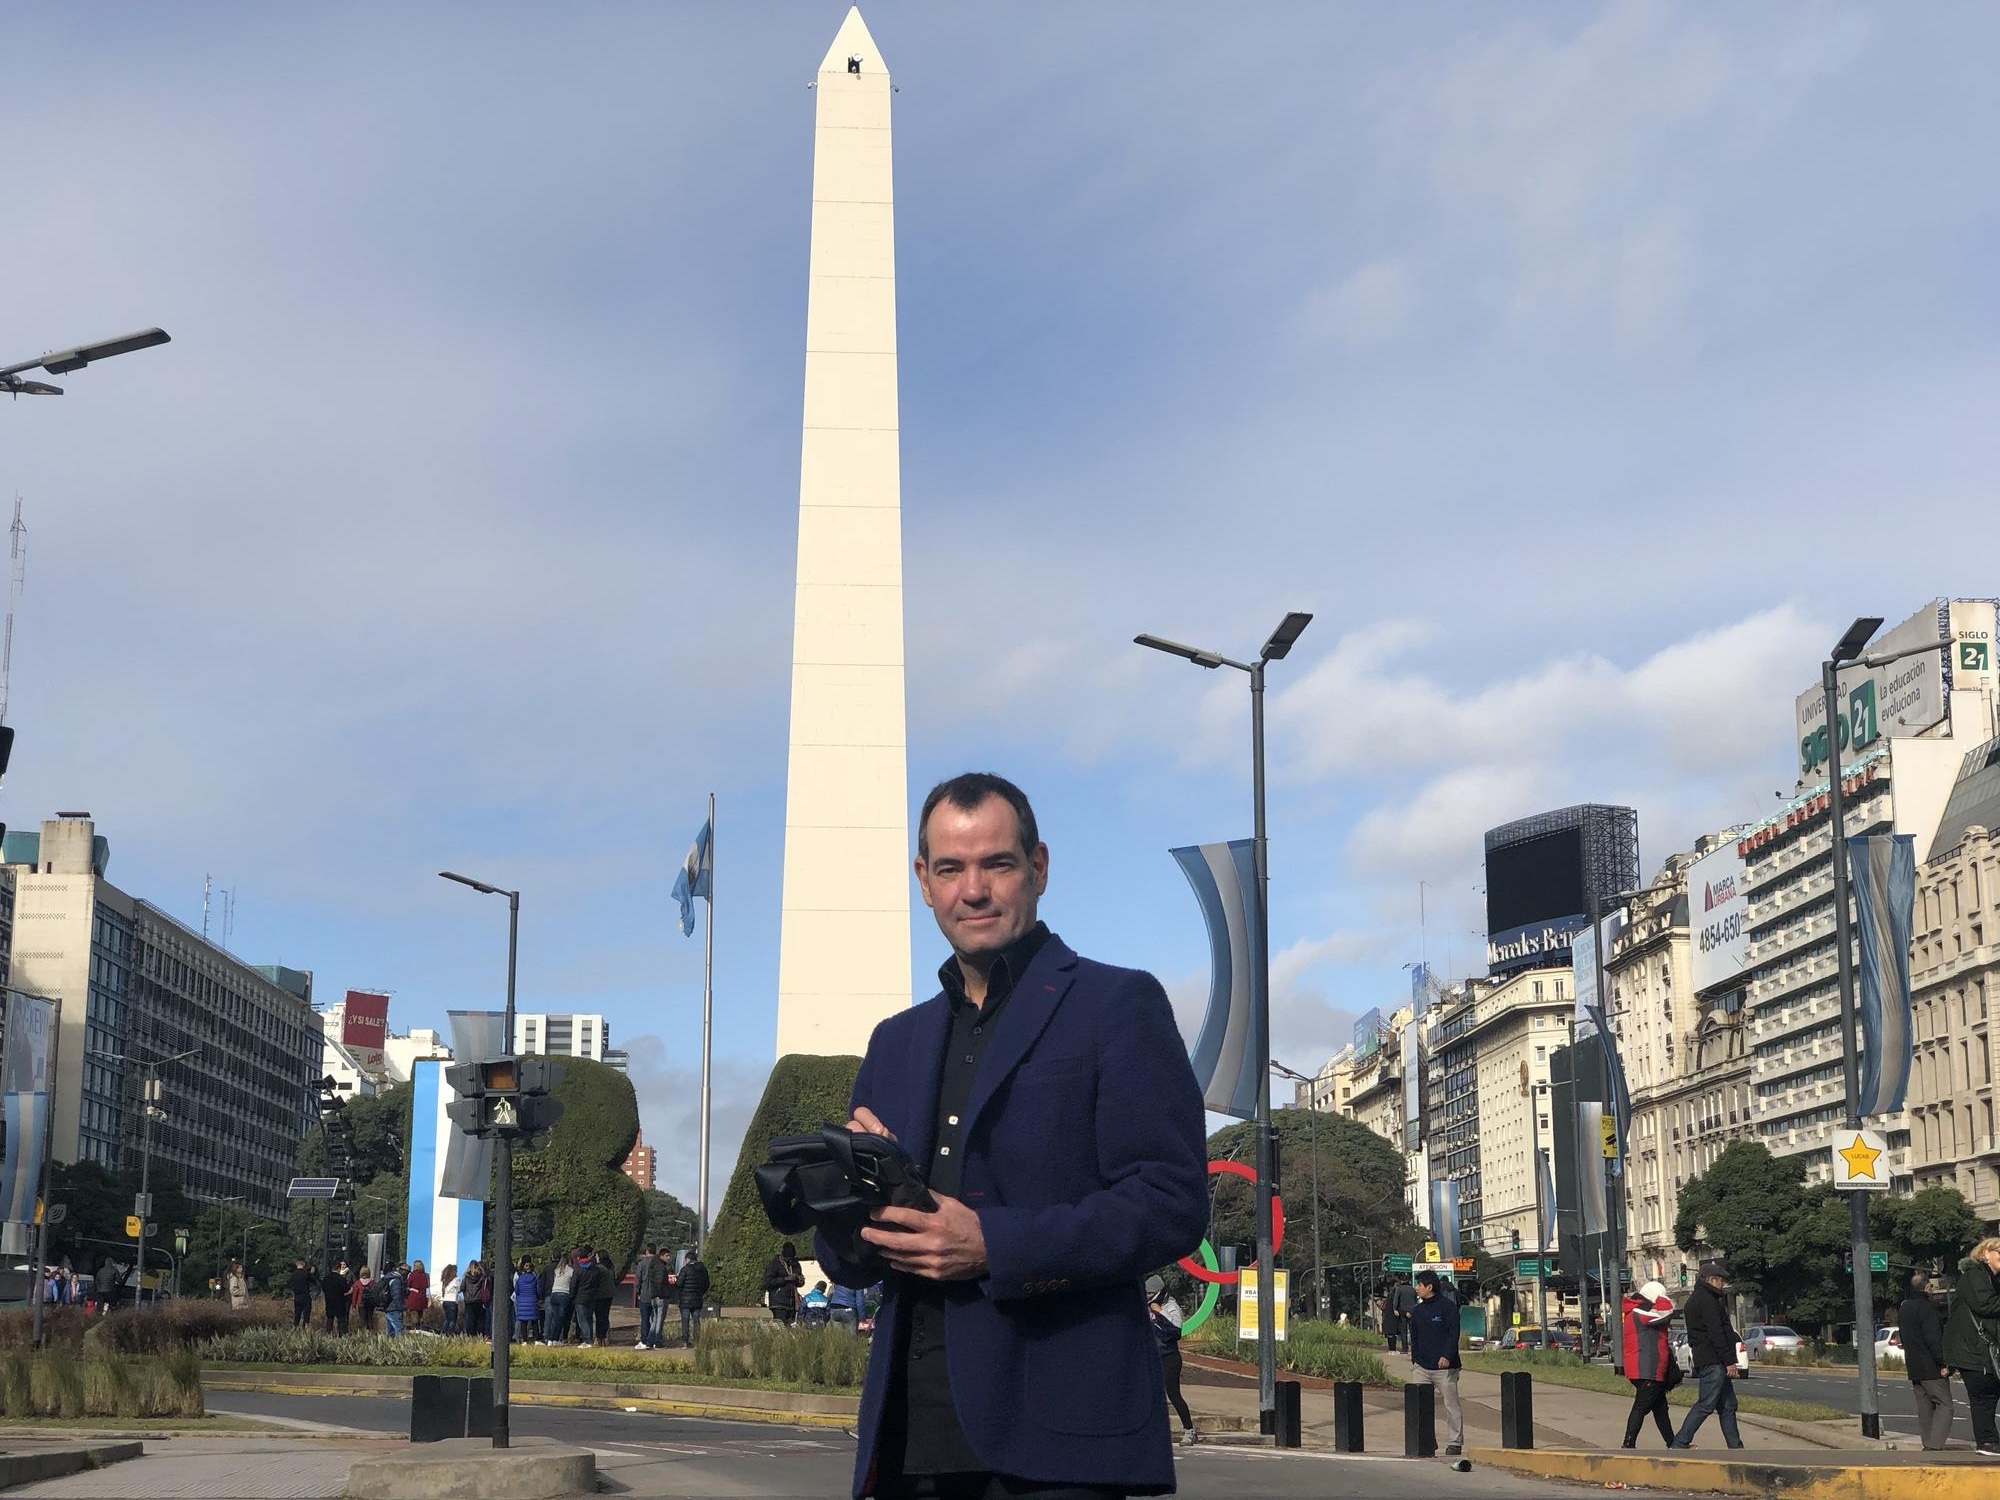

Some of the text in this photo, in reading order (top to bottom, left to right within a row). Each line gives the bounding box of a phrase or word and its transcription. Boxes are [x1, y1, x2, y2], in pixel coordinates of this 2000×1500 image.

[1959, 631, 1988, 640] SIGLO
[1964, 648, 1984, 670] 21
[1880, 661, 1926, 700] La educación
[1802, 682, 1848, 724] UNIVERAD
[1882, 687, 1921, 721] evoluciona
[1854, 699, 1869, 744] 21
[1713, 876, 1735, 895] MARCA
[1714, 886, 1737, 908] URBANA
[1488, 927, 1578, 965] Mercedes-Ben
[1700, 912, 1743, 954] 4854-650
[358, 1016, 365, 1025] SI
